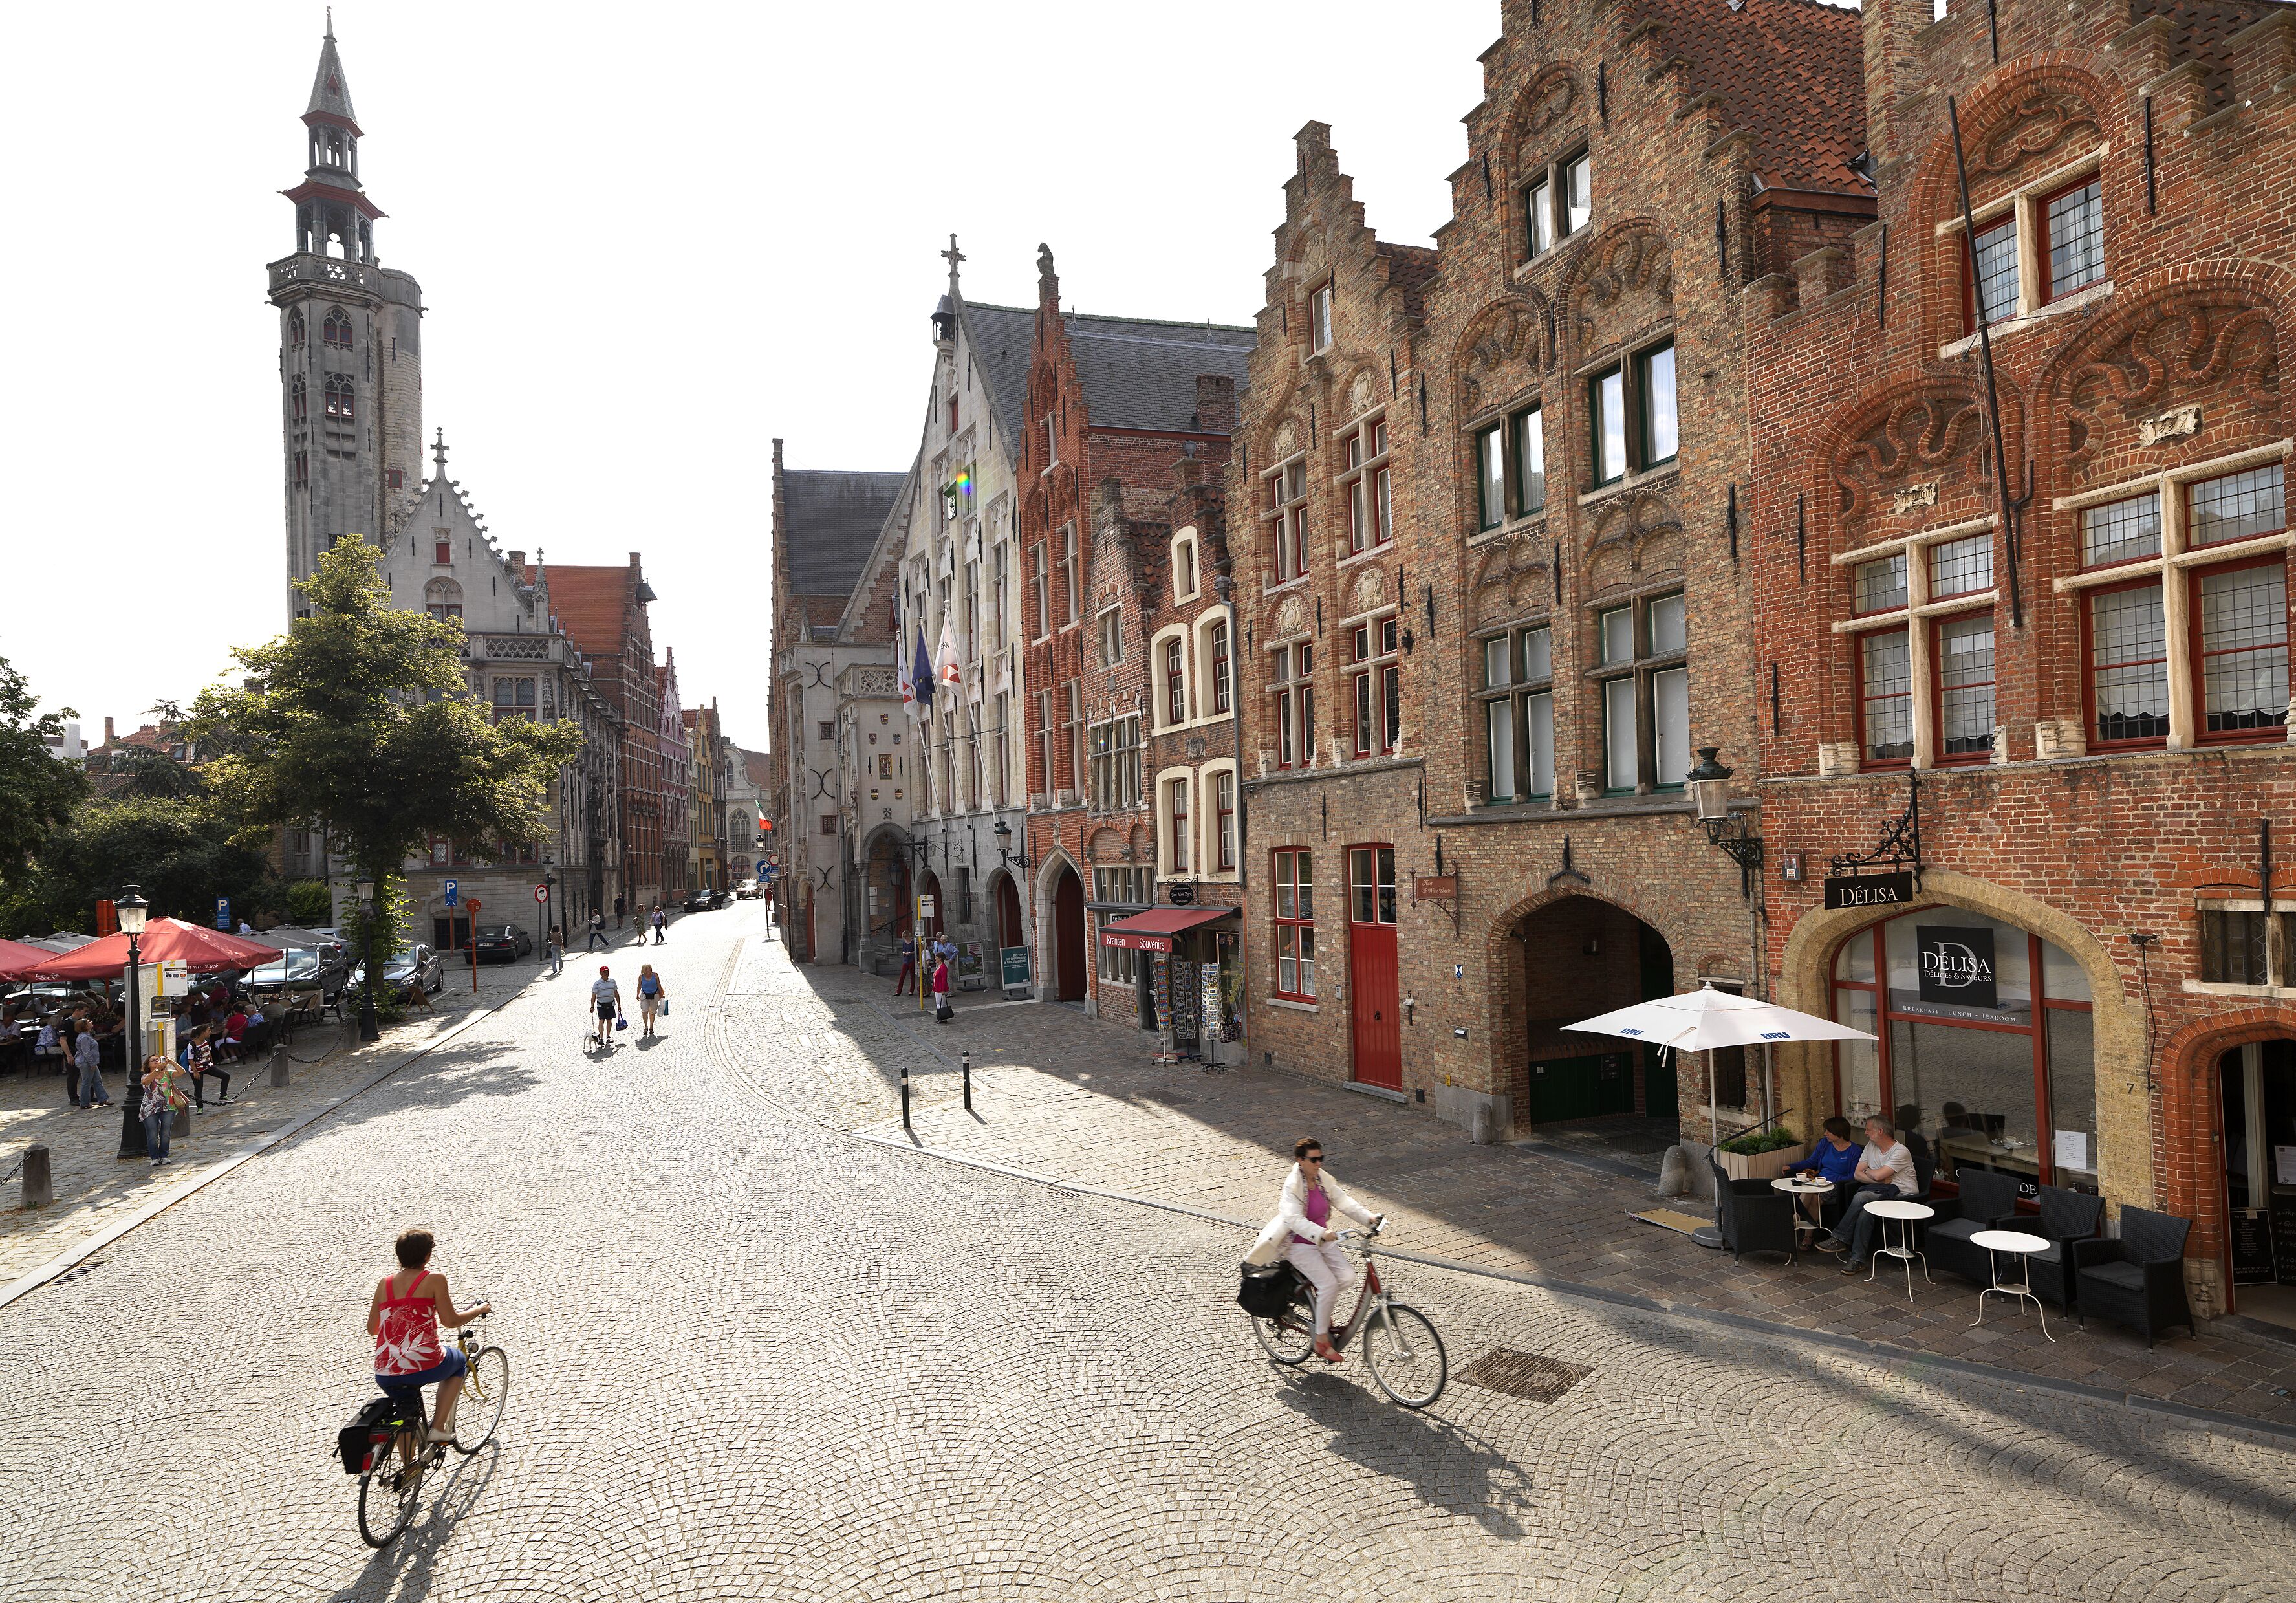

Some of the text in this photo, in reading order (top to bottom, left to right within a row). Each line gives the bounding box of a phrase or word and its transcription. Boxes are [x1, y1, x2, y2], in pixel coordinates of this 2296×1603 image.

[446, 882, 455, 893] P
[1840, 885, 1898, 906] DÉLISA
[218, 900, 228, 911] P
[1107, 935, 1165, 950] Kranten Souvenirs
[204, 963, 219, 971] Eyck
[1922, 951, 1991, 974] DÉLISA
[1924, 970, 1952, 979] DÉLICES
[1960, 973, 1991, 982] SAVEURS
[1903, 1005, 1938, 1014] BREAKFAST
[1981, 1013, 2016, 1022] TEAROOM
[2126, 1082, 2134, 1094] 7
